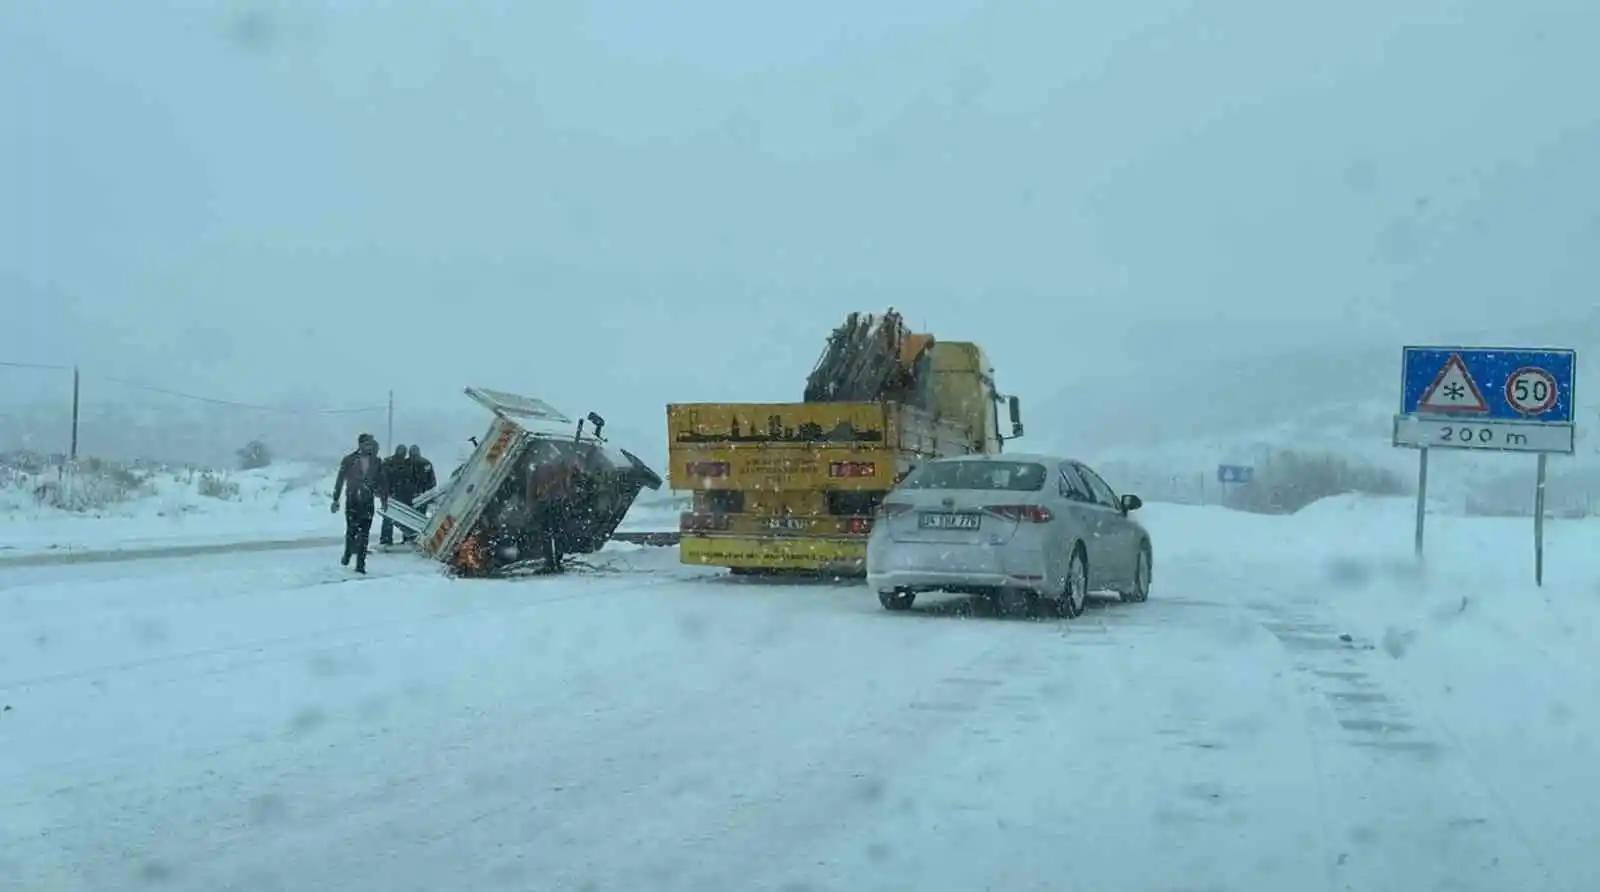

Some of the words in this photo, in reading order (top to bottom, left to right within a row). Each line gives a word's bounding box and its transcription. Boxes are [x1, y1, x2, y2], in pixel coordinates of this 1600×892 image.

[1515, 380, 1547, 401] 50
[1440, 427, 1493, 442] 200
[1506, 433, 1527, 445] m
